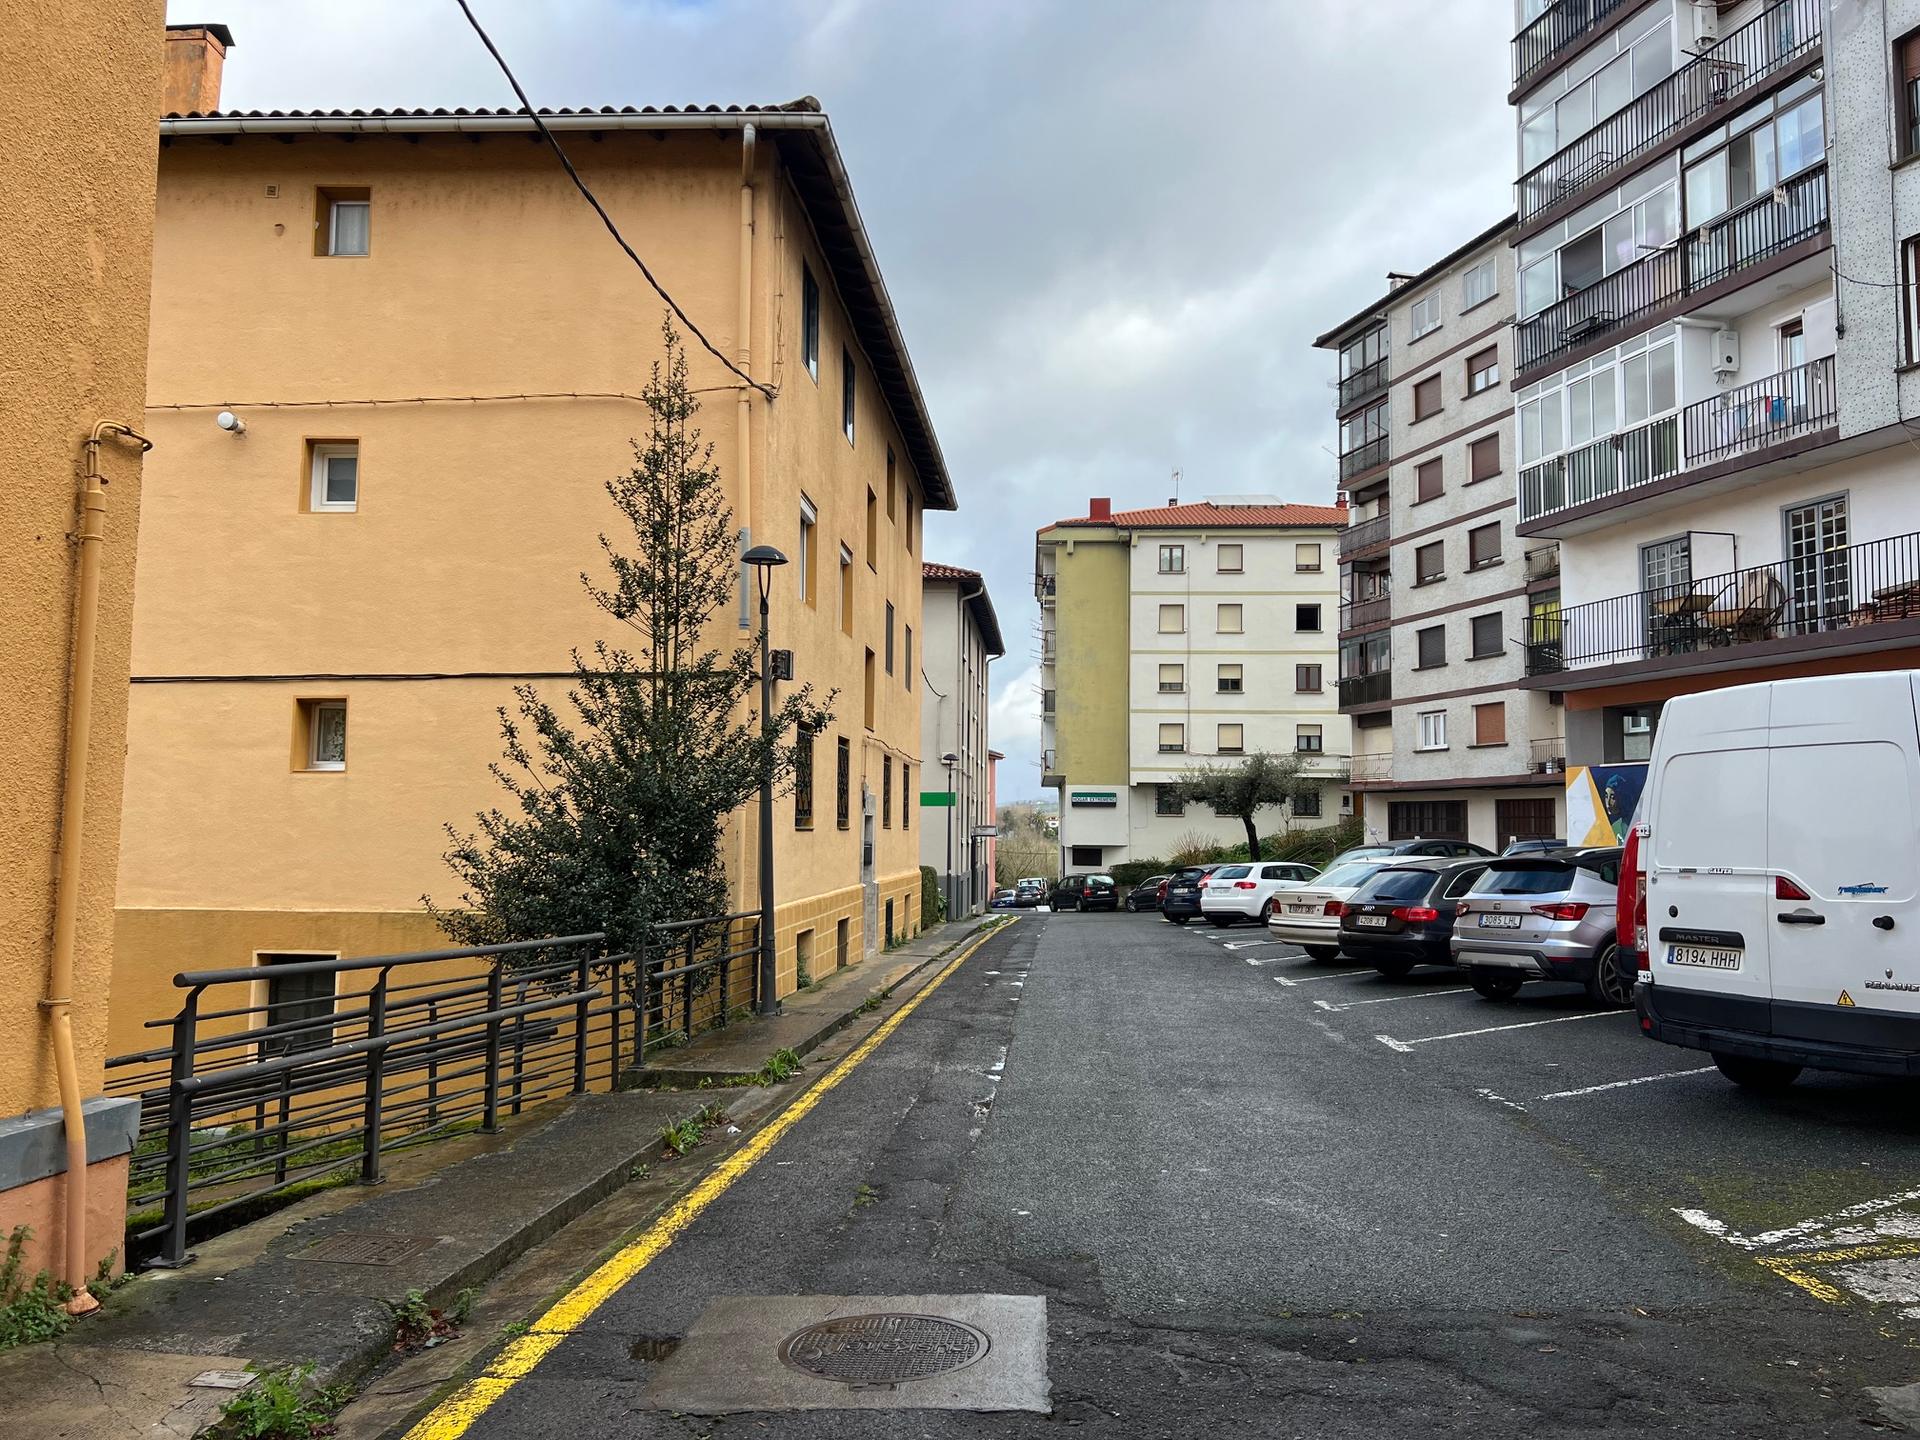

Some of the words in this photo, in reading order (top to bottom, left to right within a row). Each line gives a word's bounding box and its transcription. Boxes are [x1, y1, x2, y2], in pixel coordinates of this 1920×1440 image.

[1484, 916, 1502, 925] 3085
[1504, 917, 1518, 925] LHL
[1676, 934, 1720, 944] MASTER
[1675, 948, 1706, 965] 8194
[1711, 952, 1737, 968] HHH
[1864, 980, 1920, 992] RENAULT
